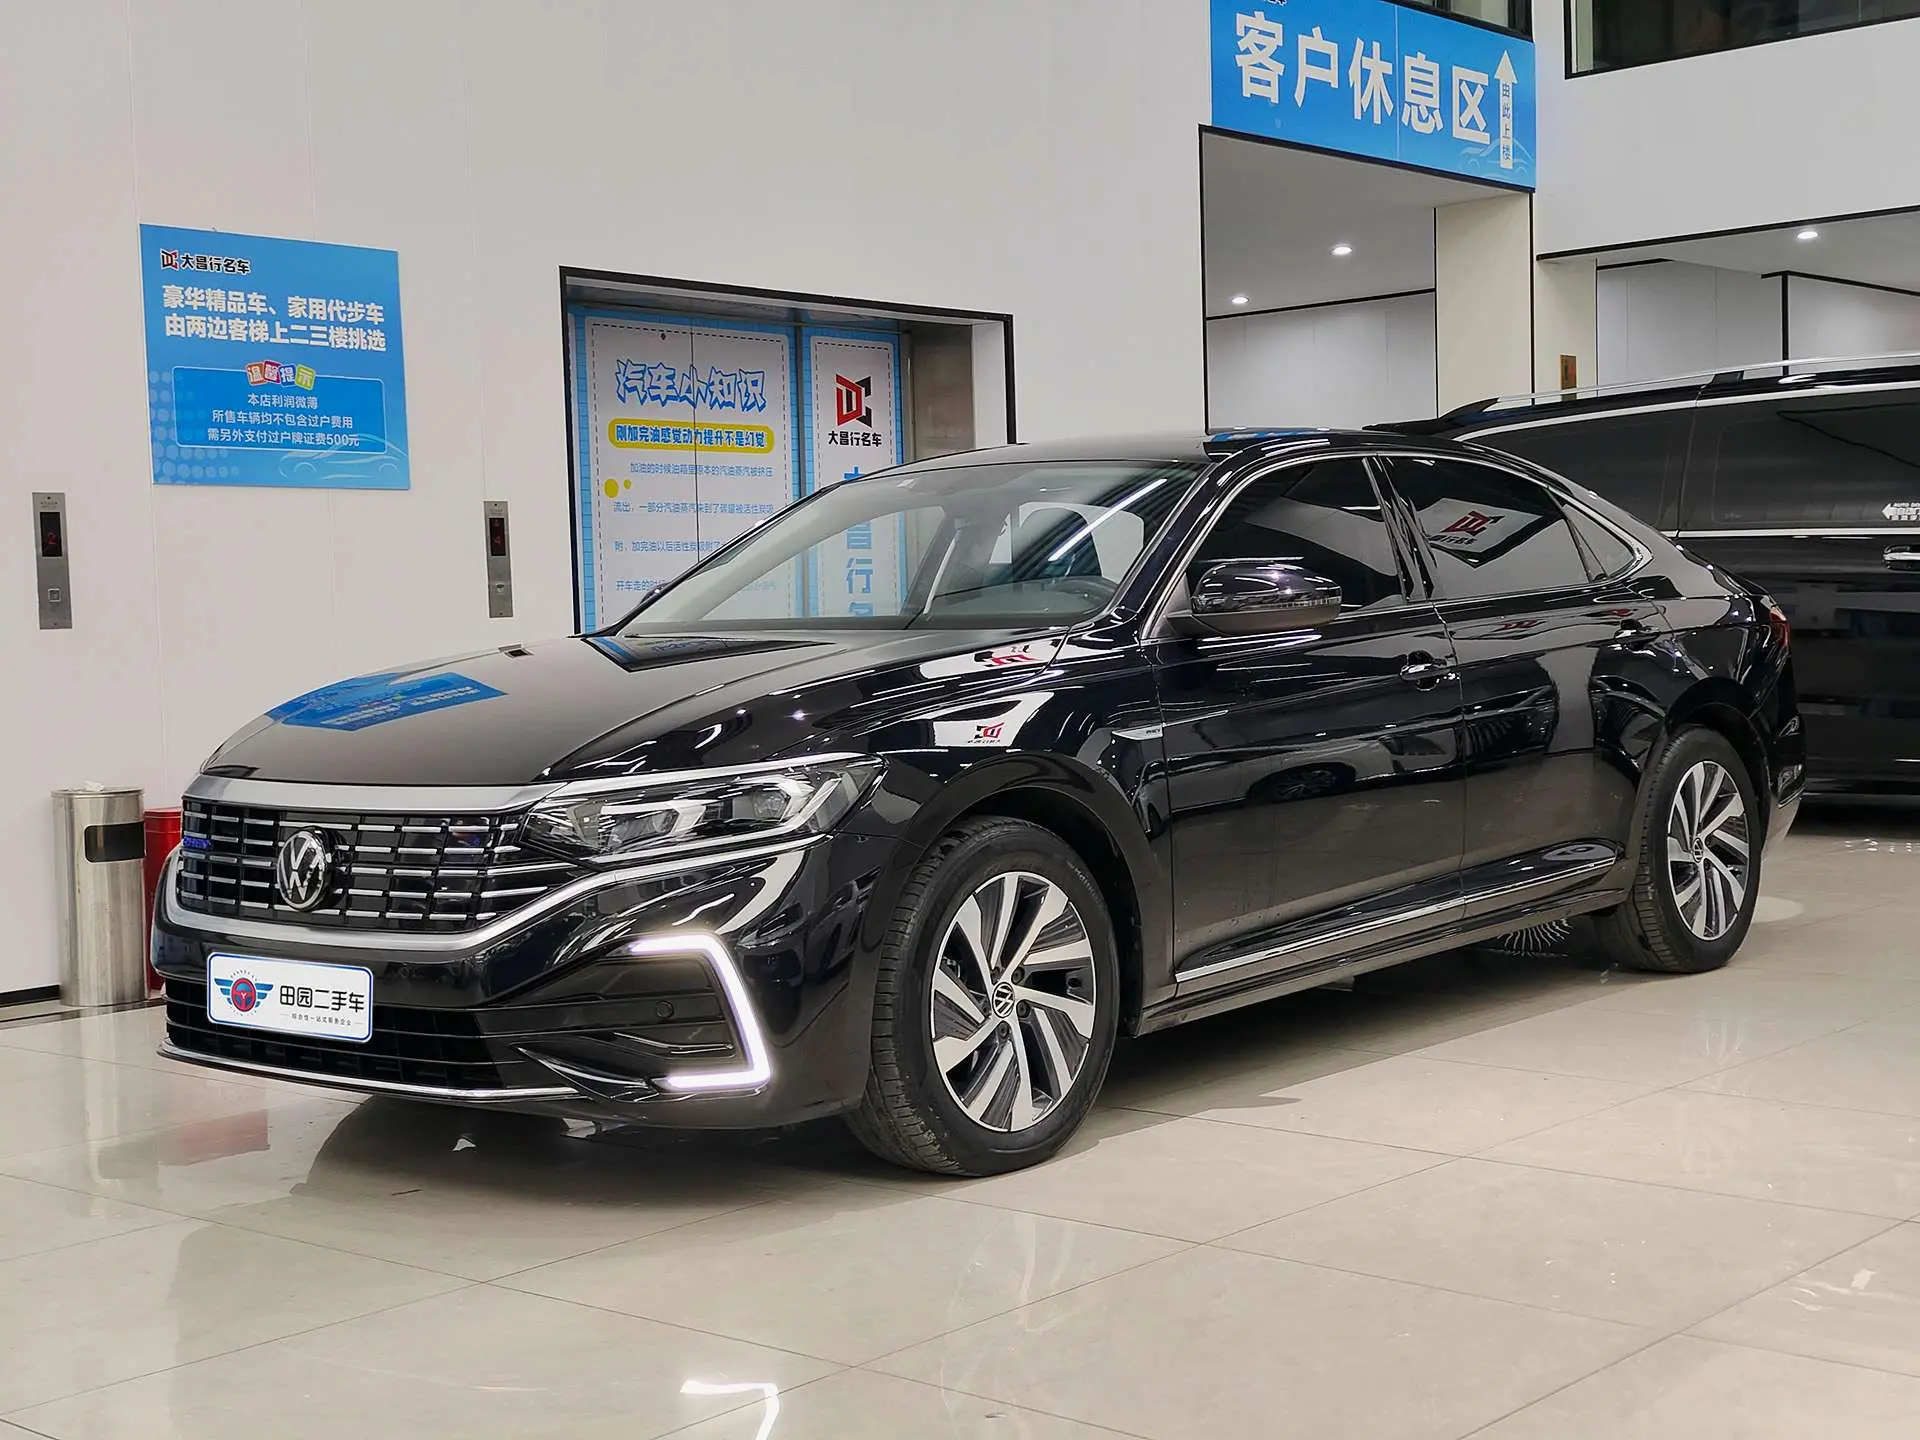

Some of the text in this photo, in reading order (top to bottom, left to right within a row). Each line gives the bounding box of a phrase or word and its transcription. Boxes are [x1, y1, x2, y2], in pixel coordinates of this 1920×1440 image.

[1235, 11, 1490, 145] 客户休息区
[181, 253, 250, 275] 大昌行名车
[164, 313, 387, 352] 由两边客梯上二三楼挑选
[615, 358, 766, 412] 汽车小知识
[247, 392, 318, 410] 本店利润微薄
[212, 409, 353, 429] 所售车辆均不包含过户费用
[207, 427, 360, 447] 需另外支付过户牌证费500元
[615, 424, 765, 448] 刚加完油感觉动力提升不是幻觉
[828, 430, 882, 447] 大昌行名车
[280, 985, 365, 1013] 田园二手车
